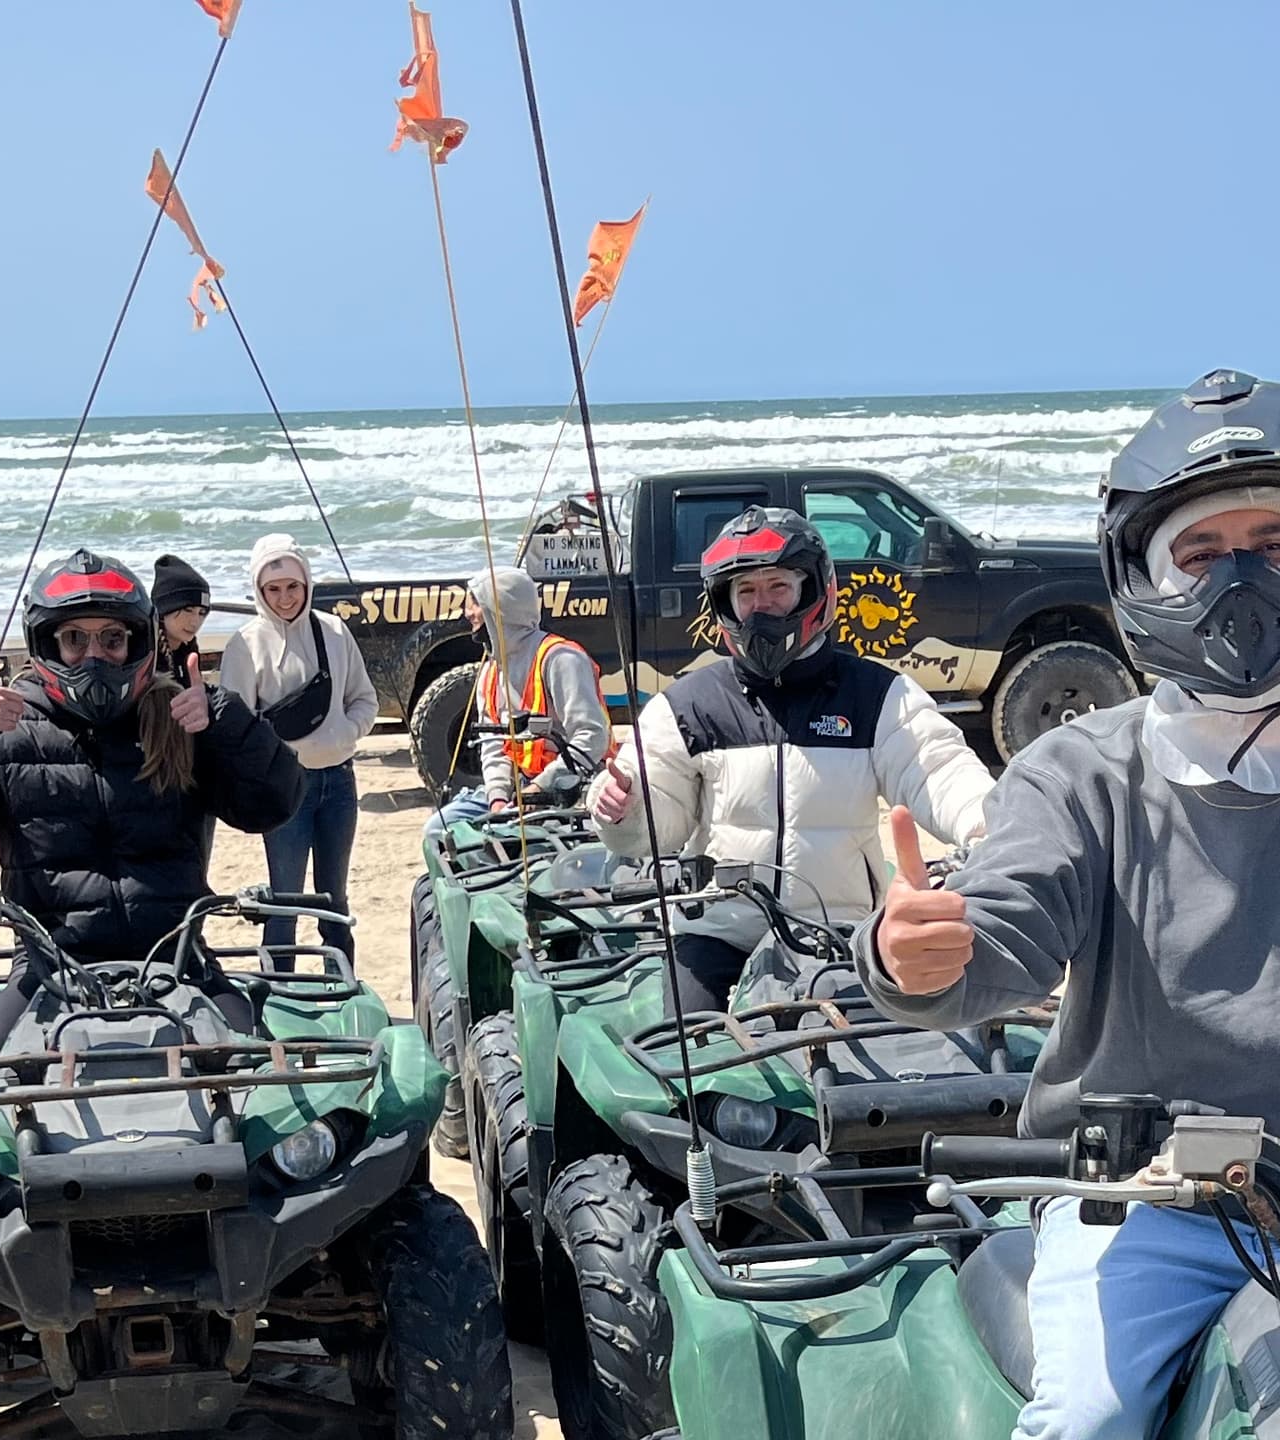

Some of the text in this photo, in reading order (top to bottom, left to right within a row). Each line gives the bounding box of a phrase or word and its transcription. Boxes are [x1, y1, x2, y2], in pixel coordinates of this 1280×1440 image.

[543, 538, 556, 550] NO
[360, 580, 608, 624] SUNBY.COM
[821, 715, 837, 723] THE
